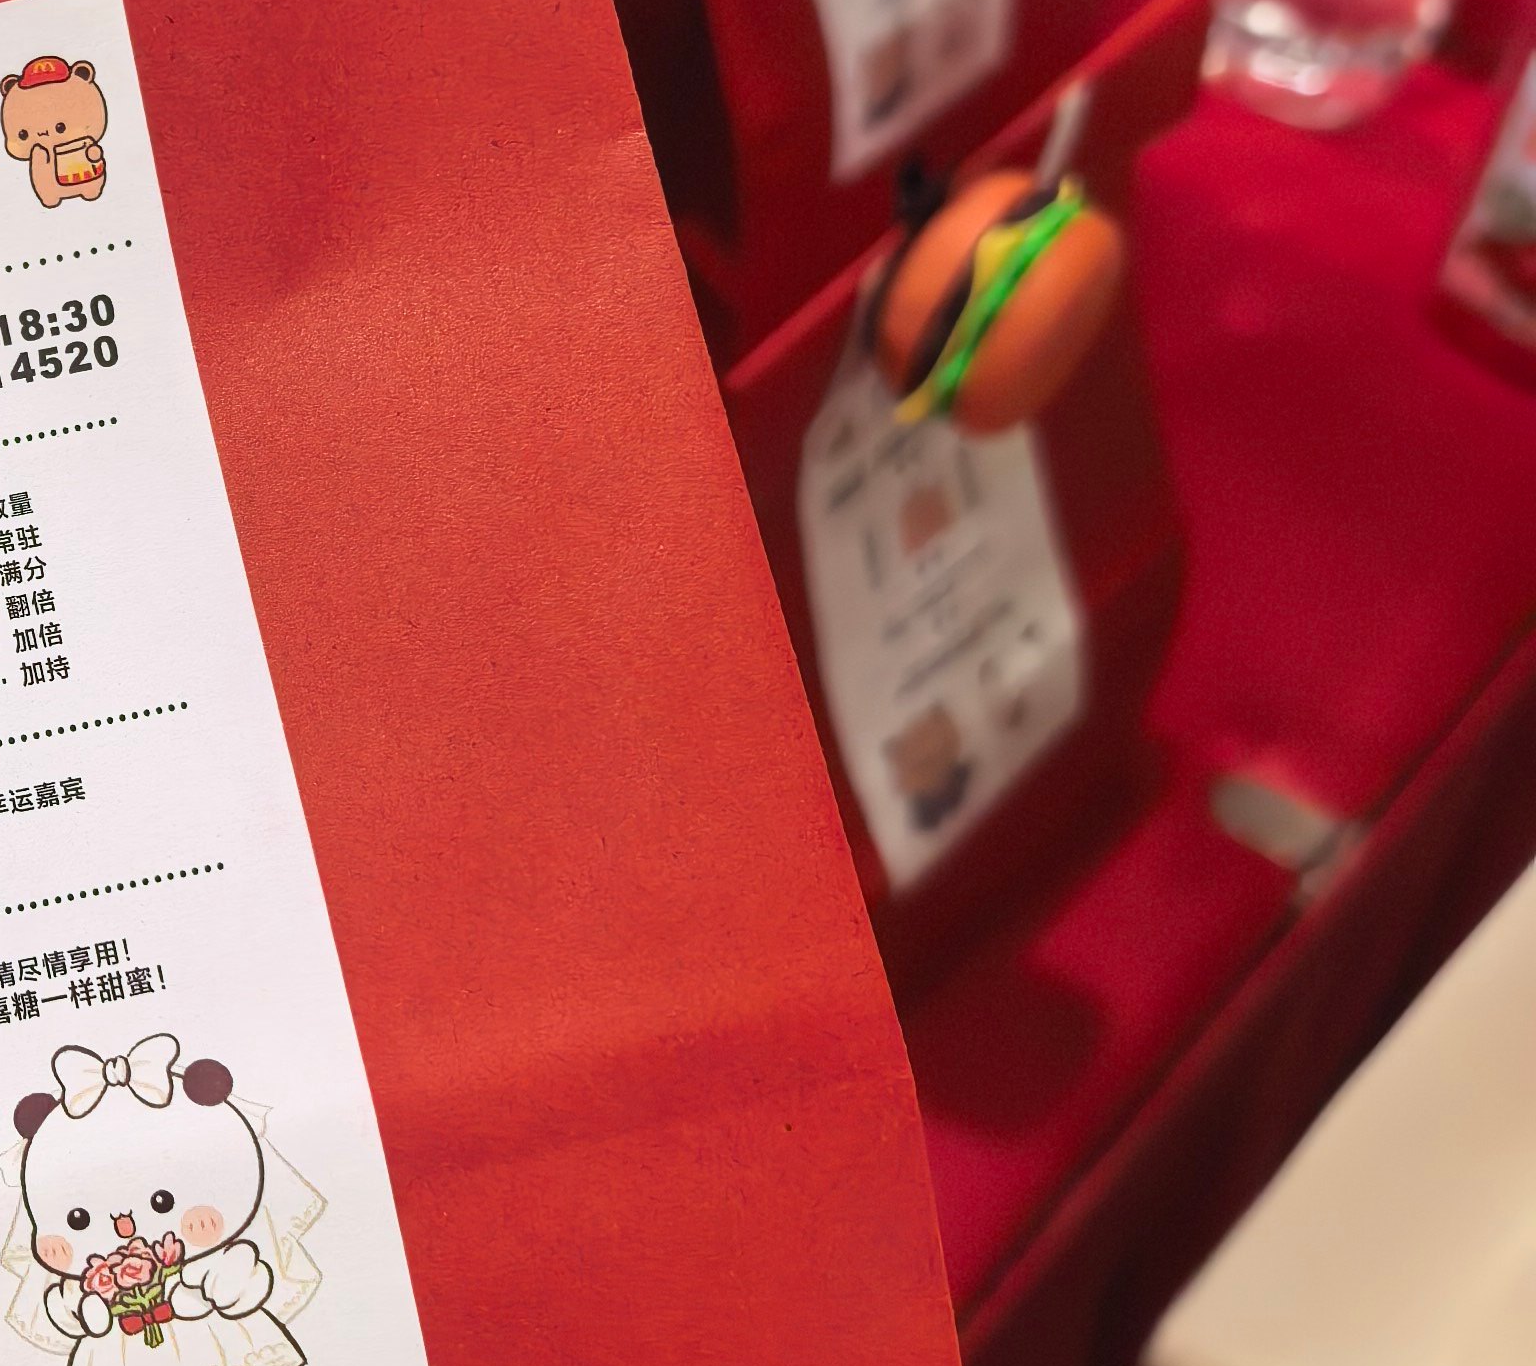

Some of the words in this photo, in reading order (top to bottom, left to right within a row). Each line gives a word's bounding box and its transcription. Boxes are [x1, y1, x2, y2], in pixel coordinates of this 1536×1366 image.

[4, 588, 56, 621] 翻倍
[12, 621, 63, 654] 加倍
[19, 654, 71, 687] 加持
